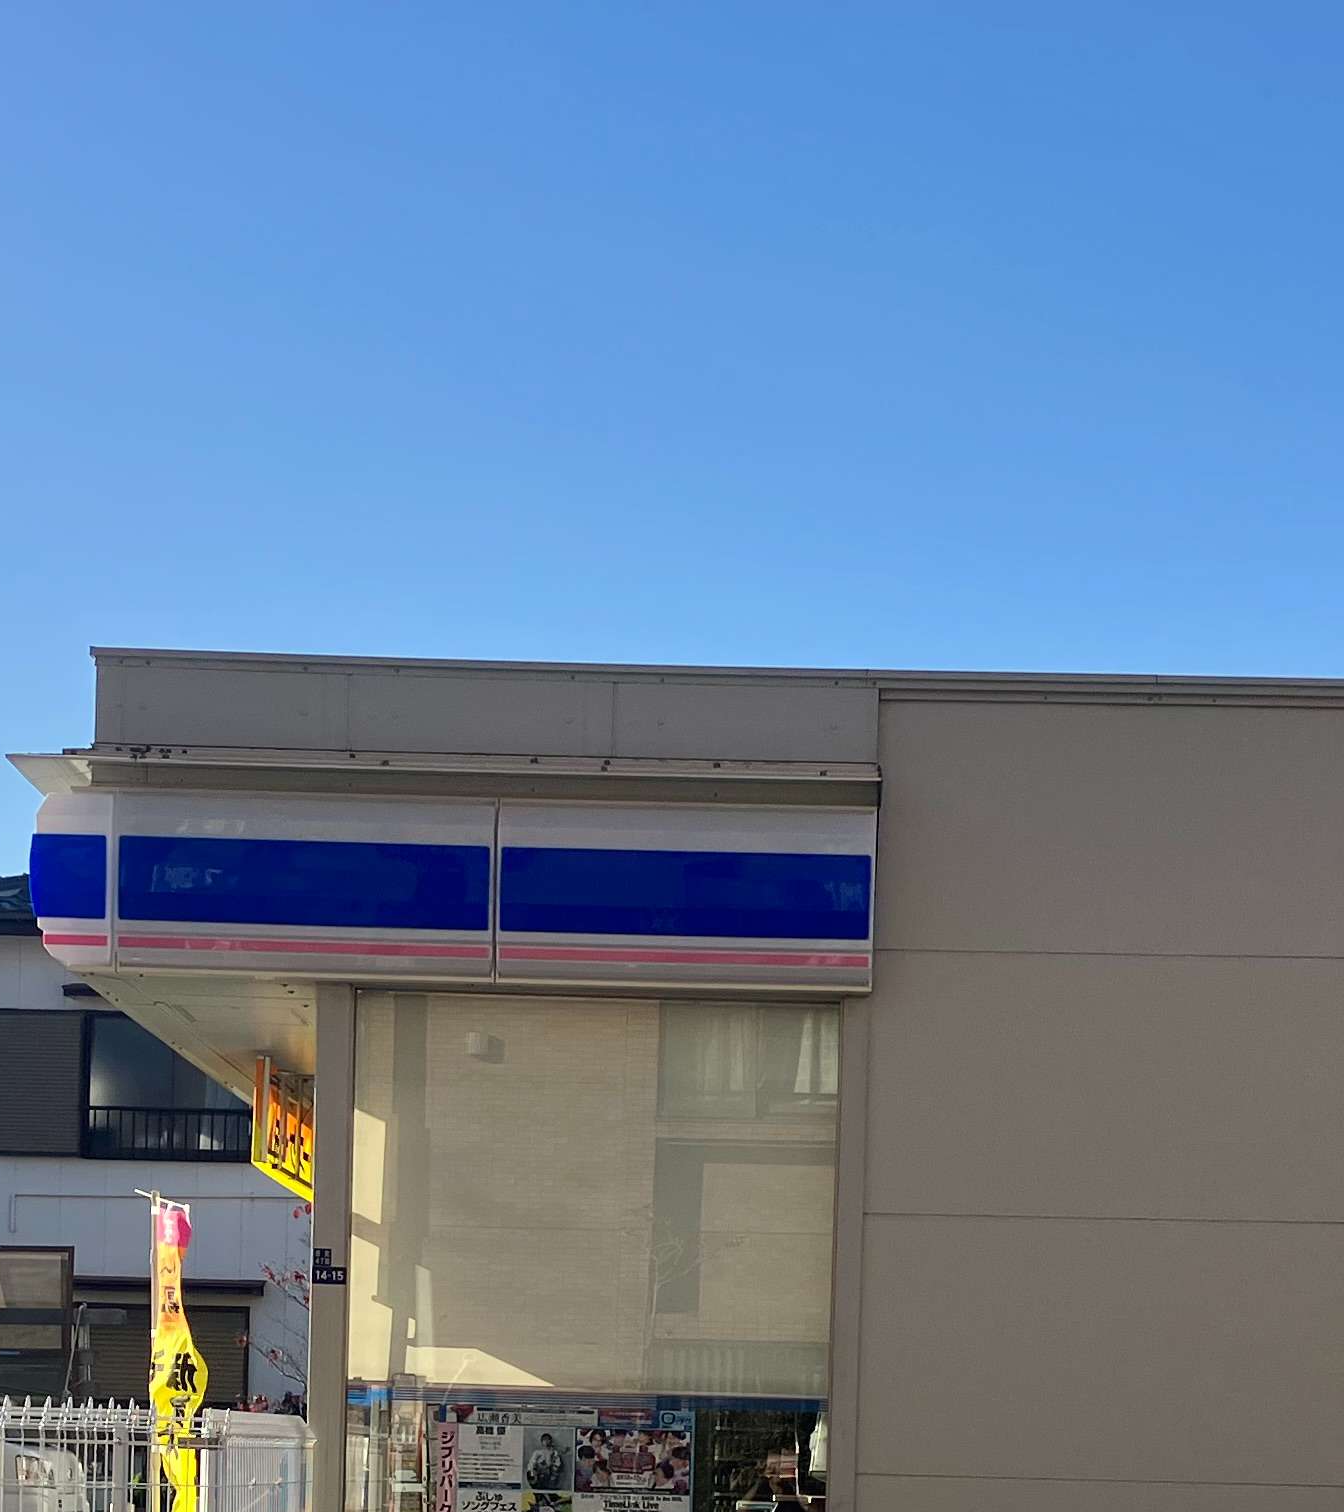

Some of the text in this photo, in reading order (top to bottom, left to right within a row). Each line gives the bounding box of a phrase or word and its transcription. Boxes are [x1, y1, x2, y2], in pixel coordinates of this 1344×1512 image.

[316, 1270, 344, 1281] 14-15
[462, 1501, 517, 1511] ソングフェス
[642, 1501, 660, 1509] Live
